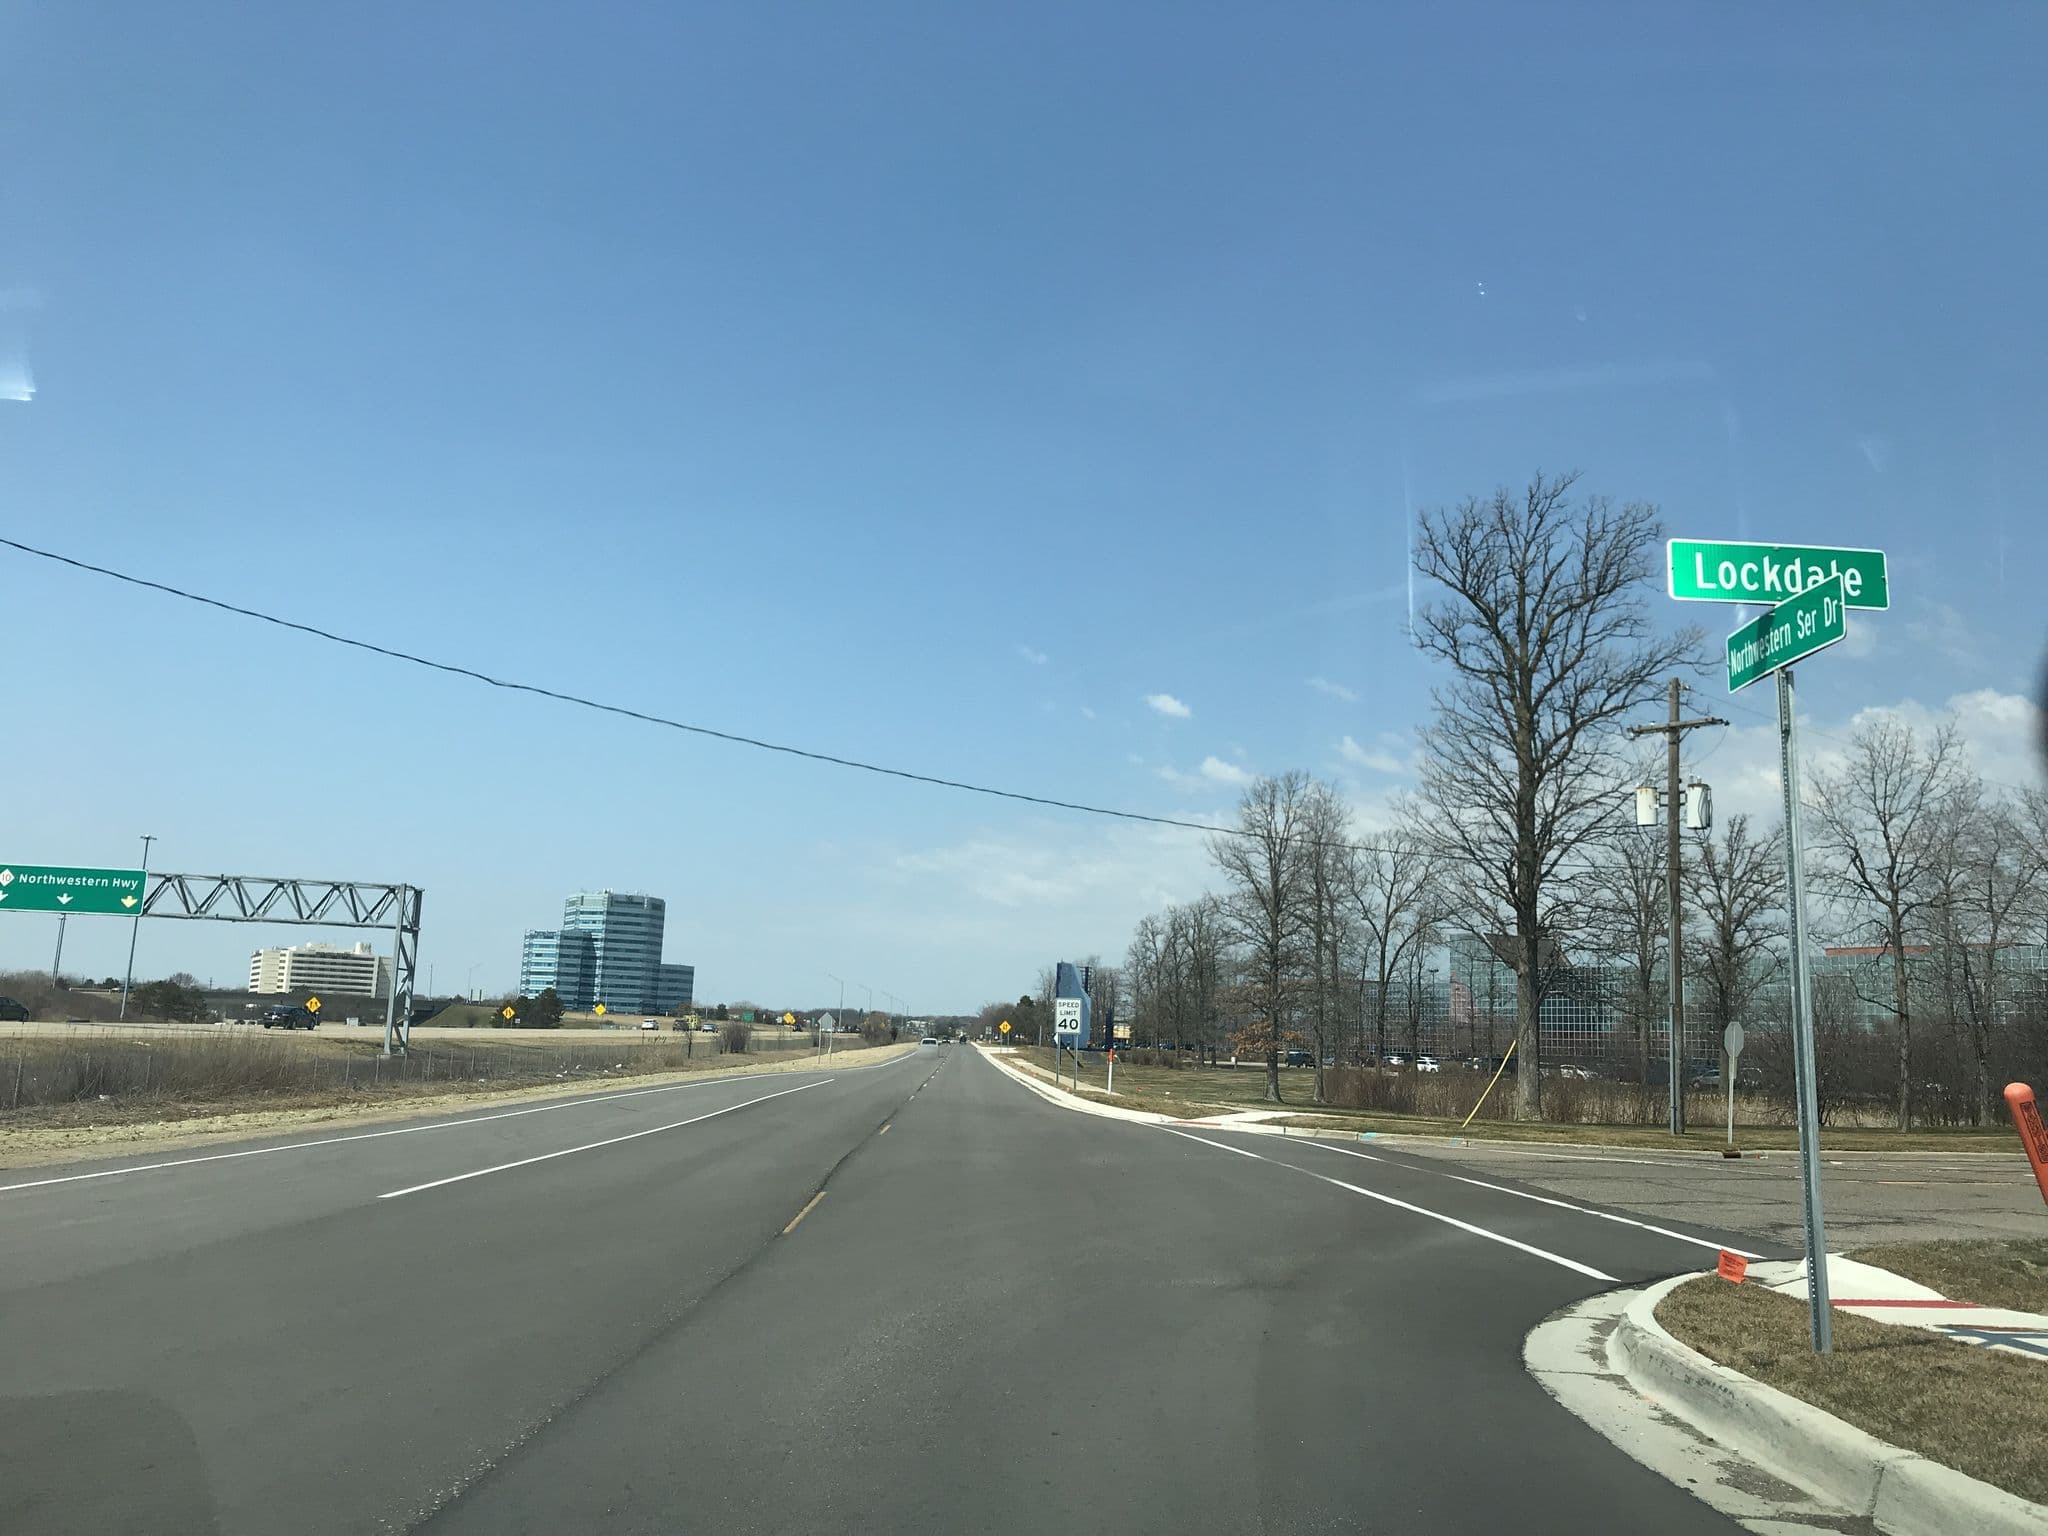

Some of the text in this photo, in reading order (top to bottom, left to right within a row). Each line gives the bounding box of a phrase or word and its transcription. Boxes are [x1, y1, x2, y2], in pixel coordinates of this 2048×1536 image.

[1730, 596, 1839, 677] Northwestern Ser Dr
[18, 873, 109, 887] Northwestern
[112, 878, 139, 890] Hwy
[1058, 1018, 1079, 1030] 40
